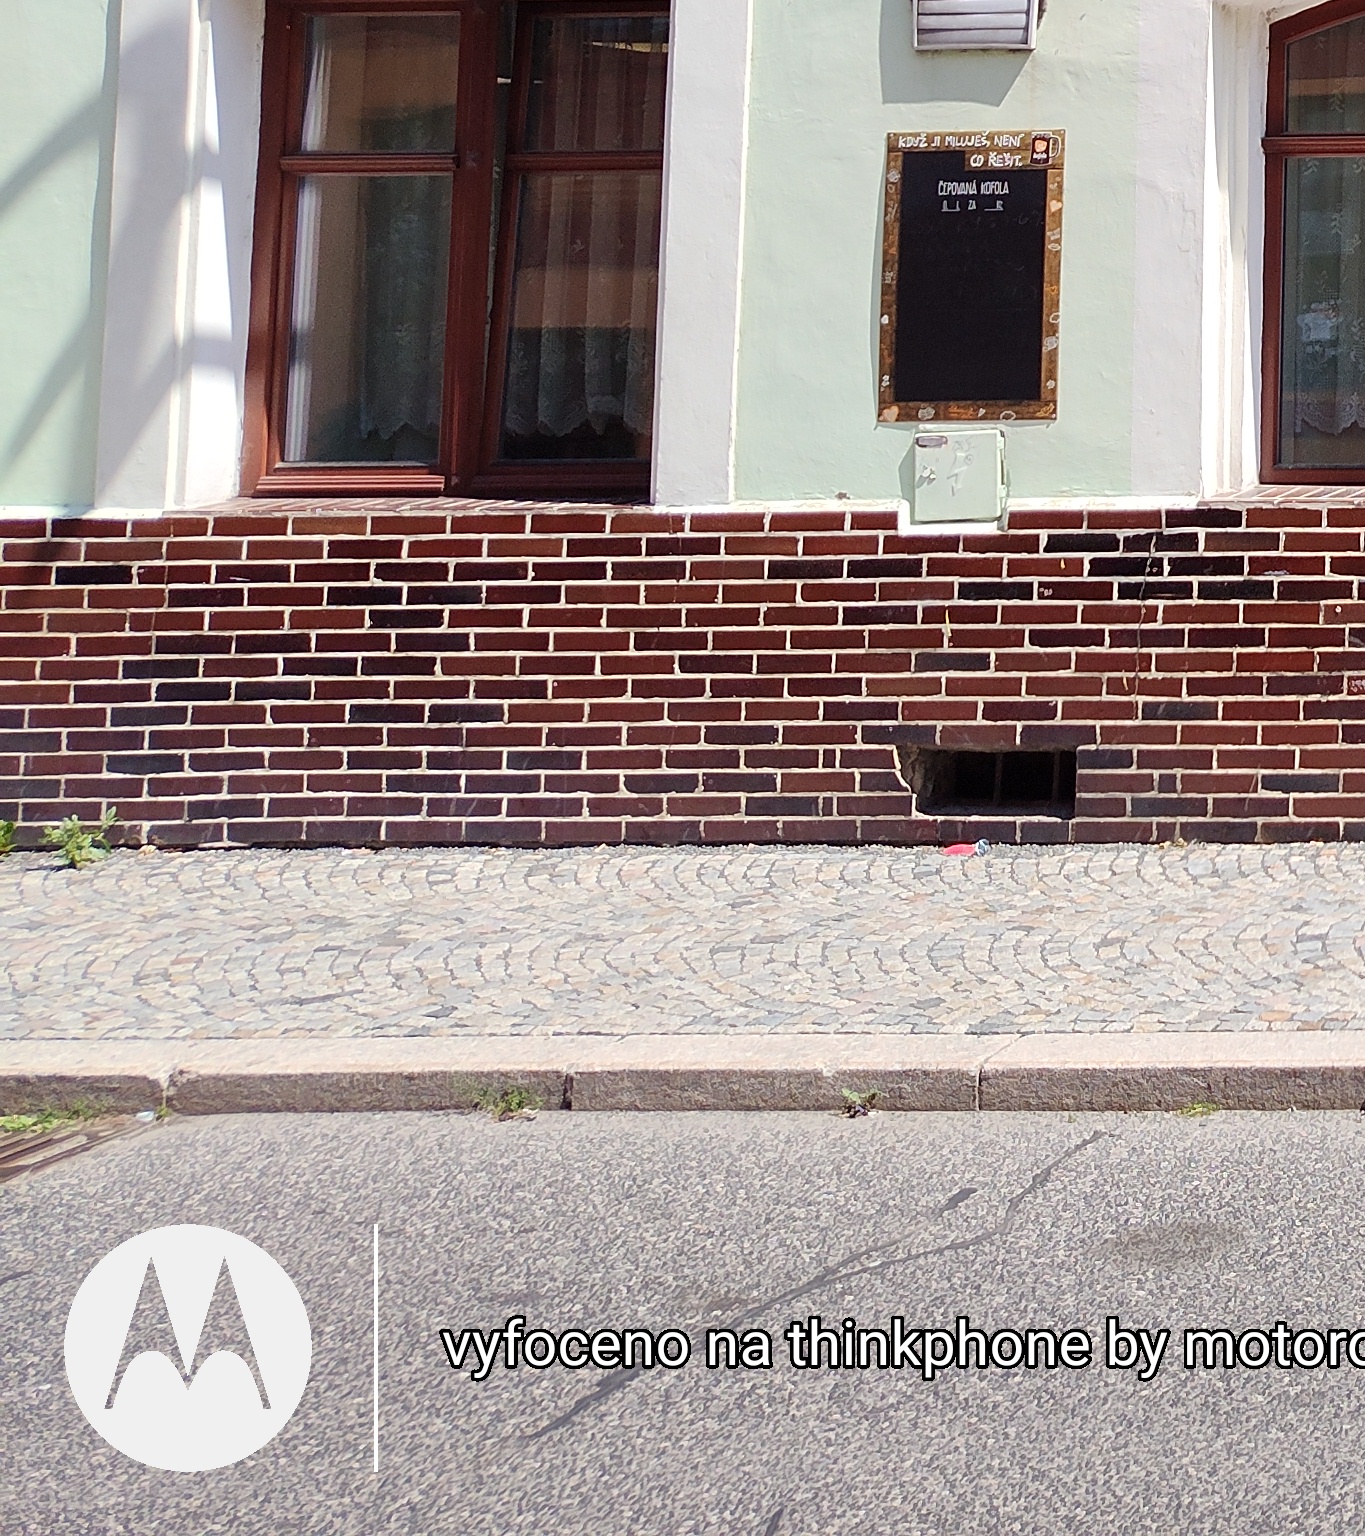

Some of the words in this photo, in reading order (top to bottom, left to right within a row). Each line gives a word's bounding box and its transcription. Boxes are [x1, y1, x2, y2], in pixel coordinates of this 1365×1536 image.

[898, 133, 928, 148] KDYŽ
[931, 136, 941, 147] JI
[994, 133, 1025, 148] NENÍ
[970, 155, 984, 167] CO
[938, 179, 977, 196] ČEPOVANÁ
[980, 181, 1009, 195] KOFOLA
